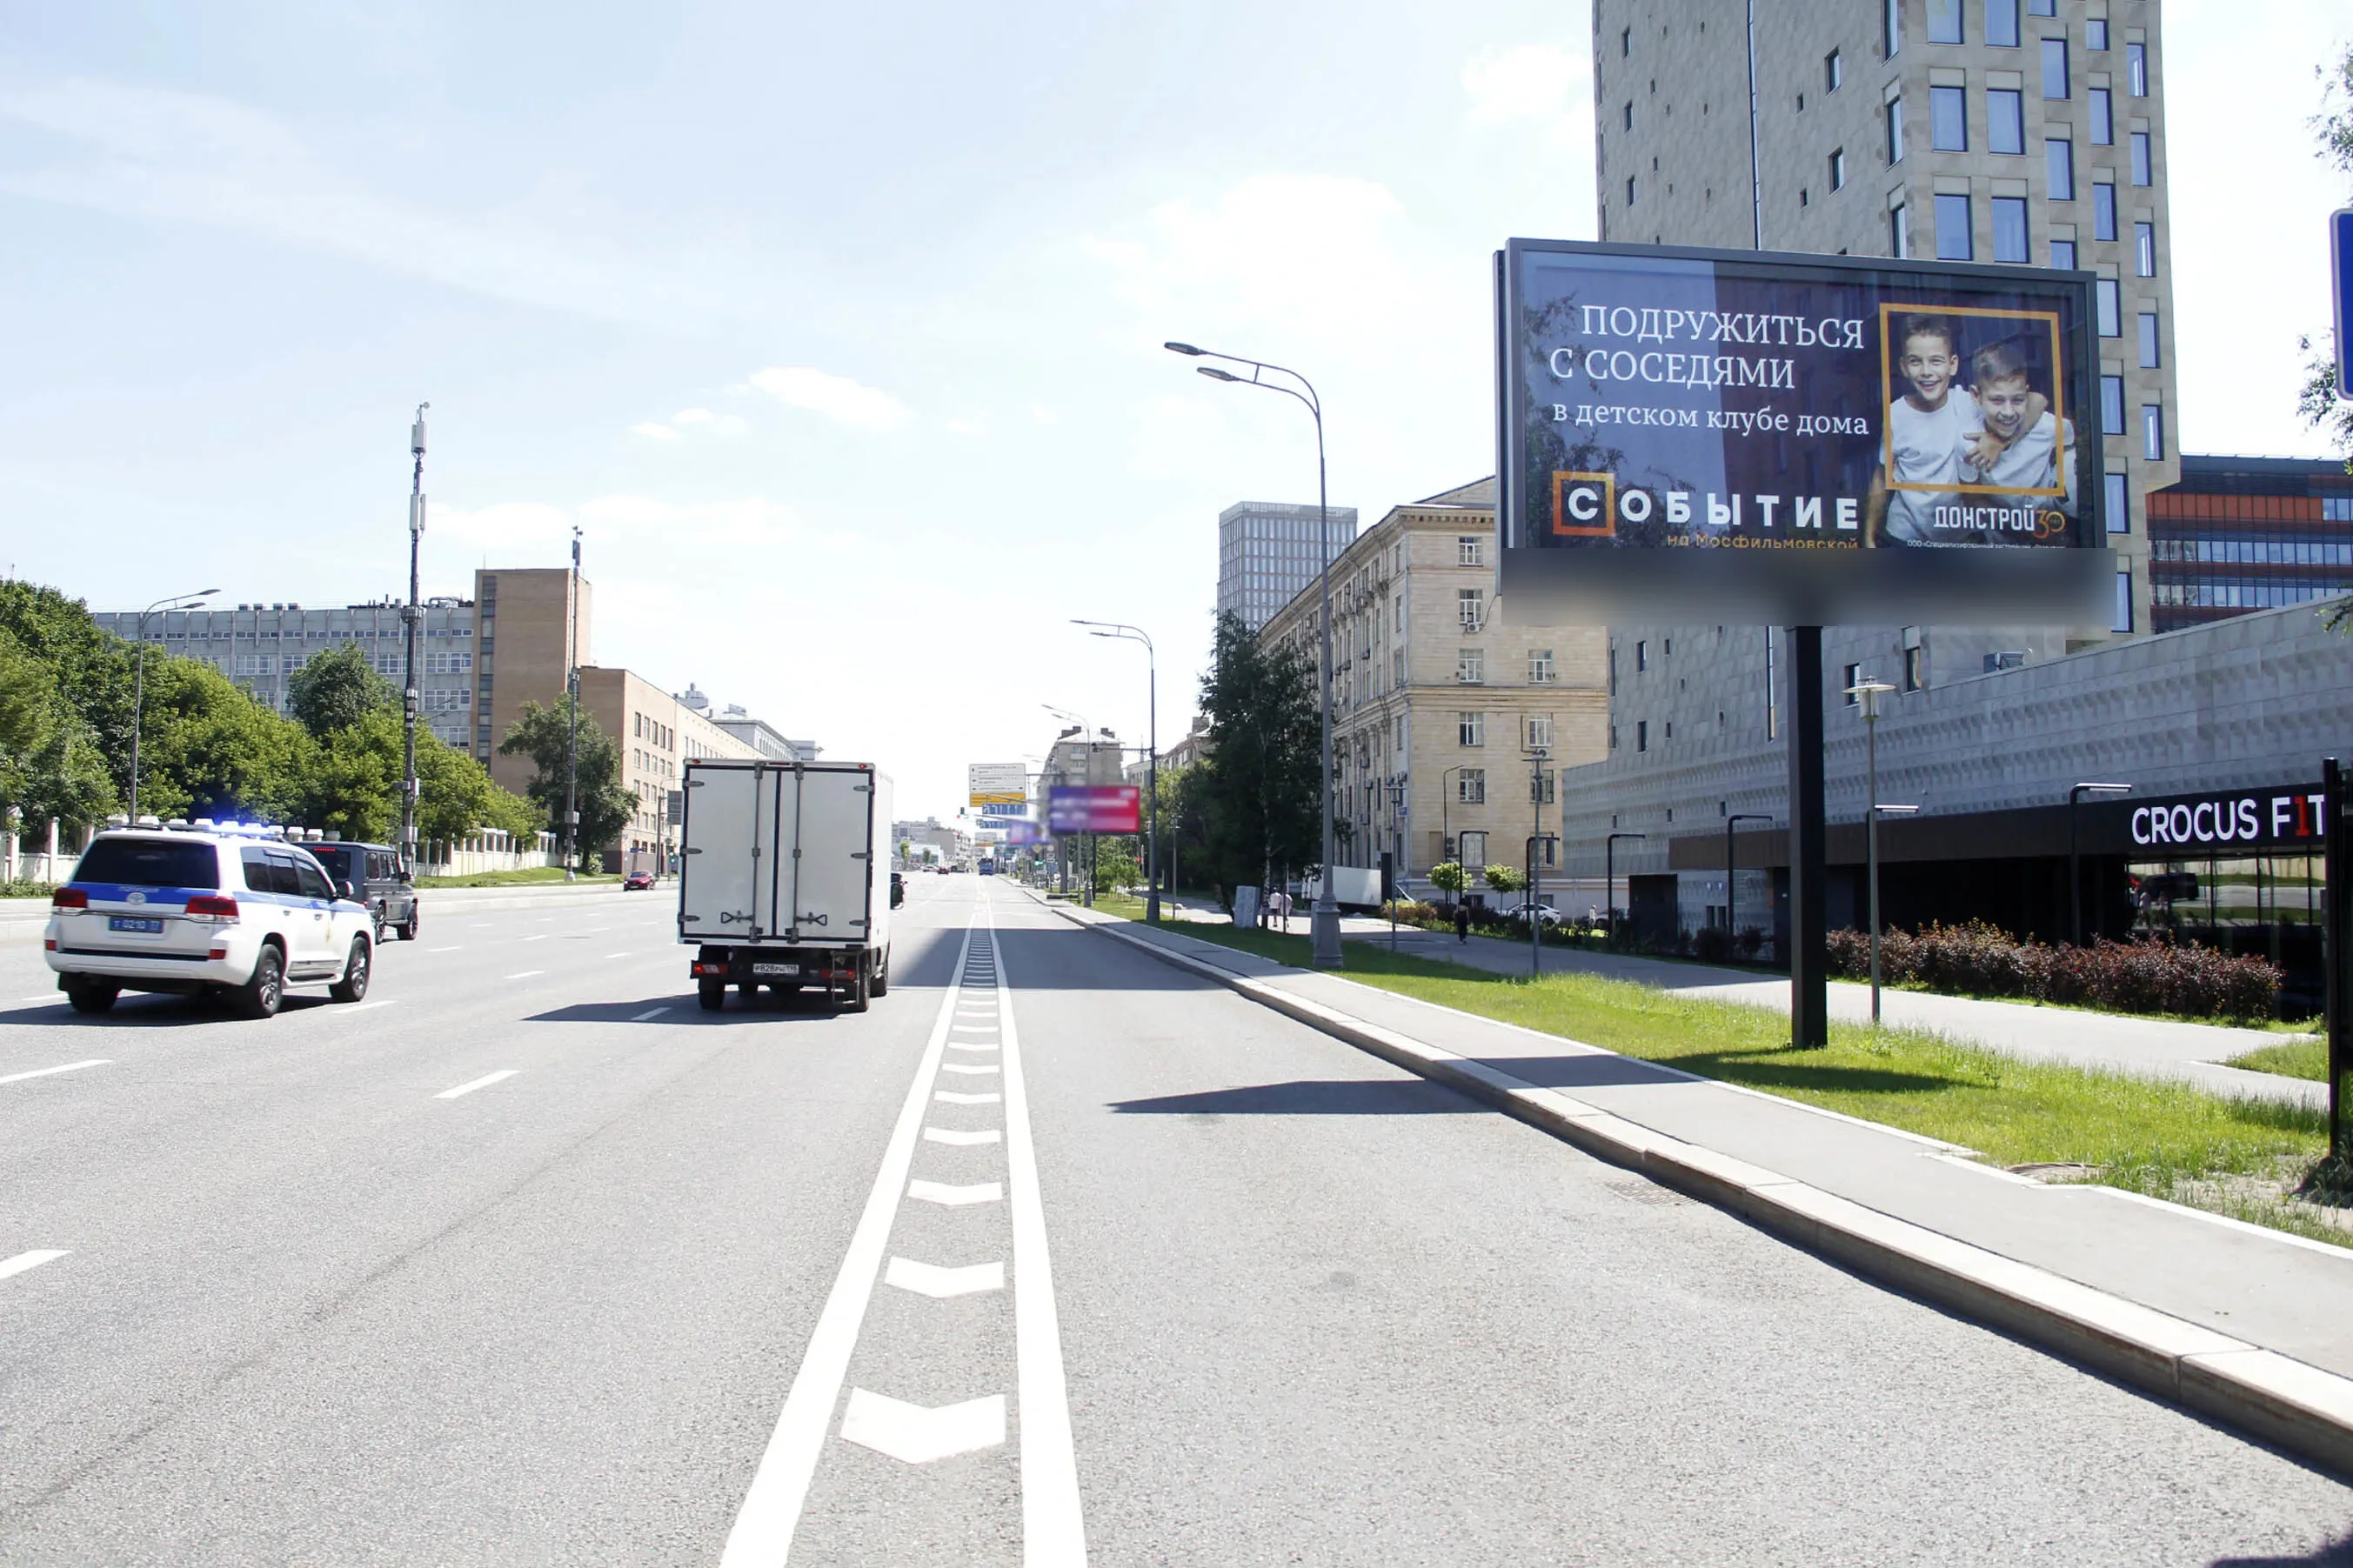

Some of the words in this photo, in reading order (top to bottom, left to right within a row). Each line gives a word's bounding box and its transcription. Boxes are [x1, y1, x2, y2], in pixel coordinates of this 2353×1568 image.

[1581, 304, 1865, 349] ПОДРУЖИТЬСЯ
[1549, 348, 1574, 378] С
[1584, 350, 1796, 390] СОСЕДЯМИ
[1553, 403, 1568, 421] в
[1575, 404, 1699, 427] детском
[1706, 405, 1789, 437] клубе
[1796, 414, 1869, 437] дома
[1568, 486, 1858, 530] СОБЫТИЕ
[1933, 504, 2035, 531] ДОНСТРОЙ
[1668, 535, 1690, 547] на
[2131, 797, 2259, 844] CROCUS
